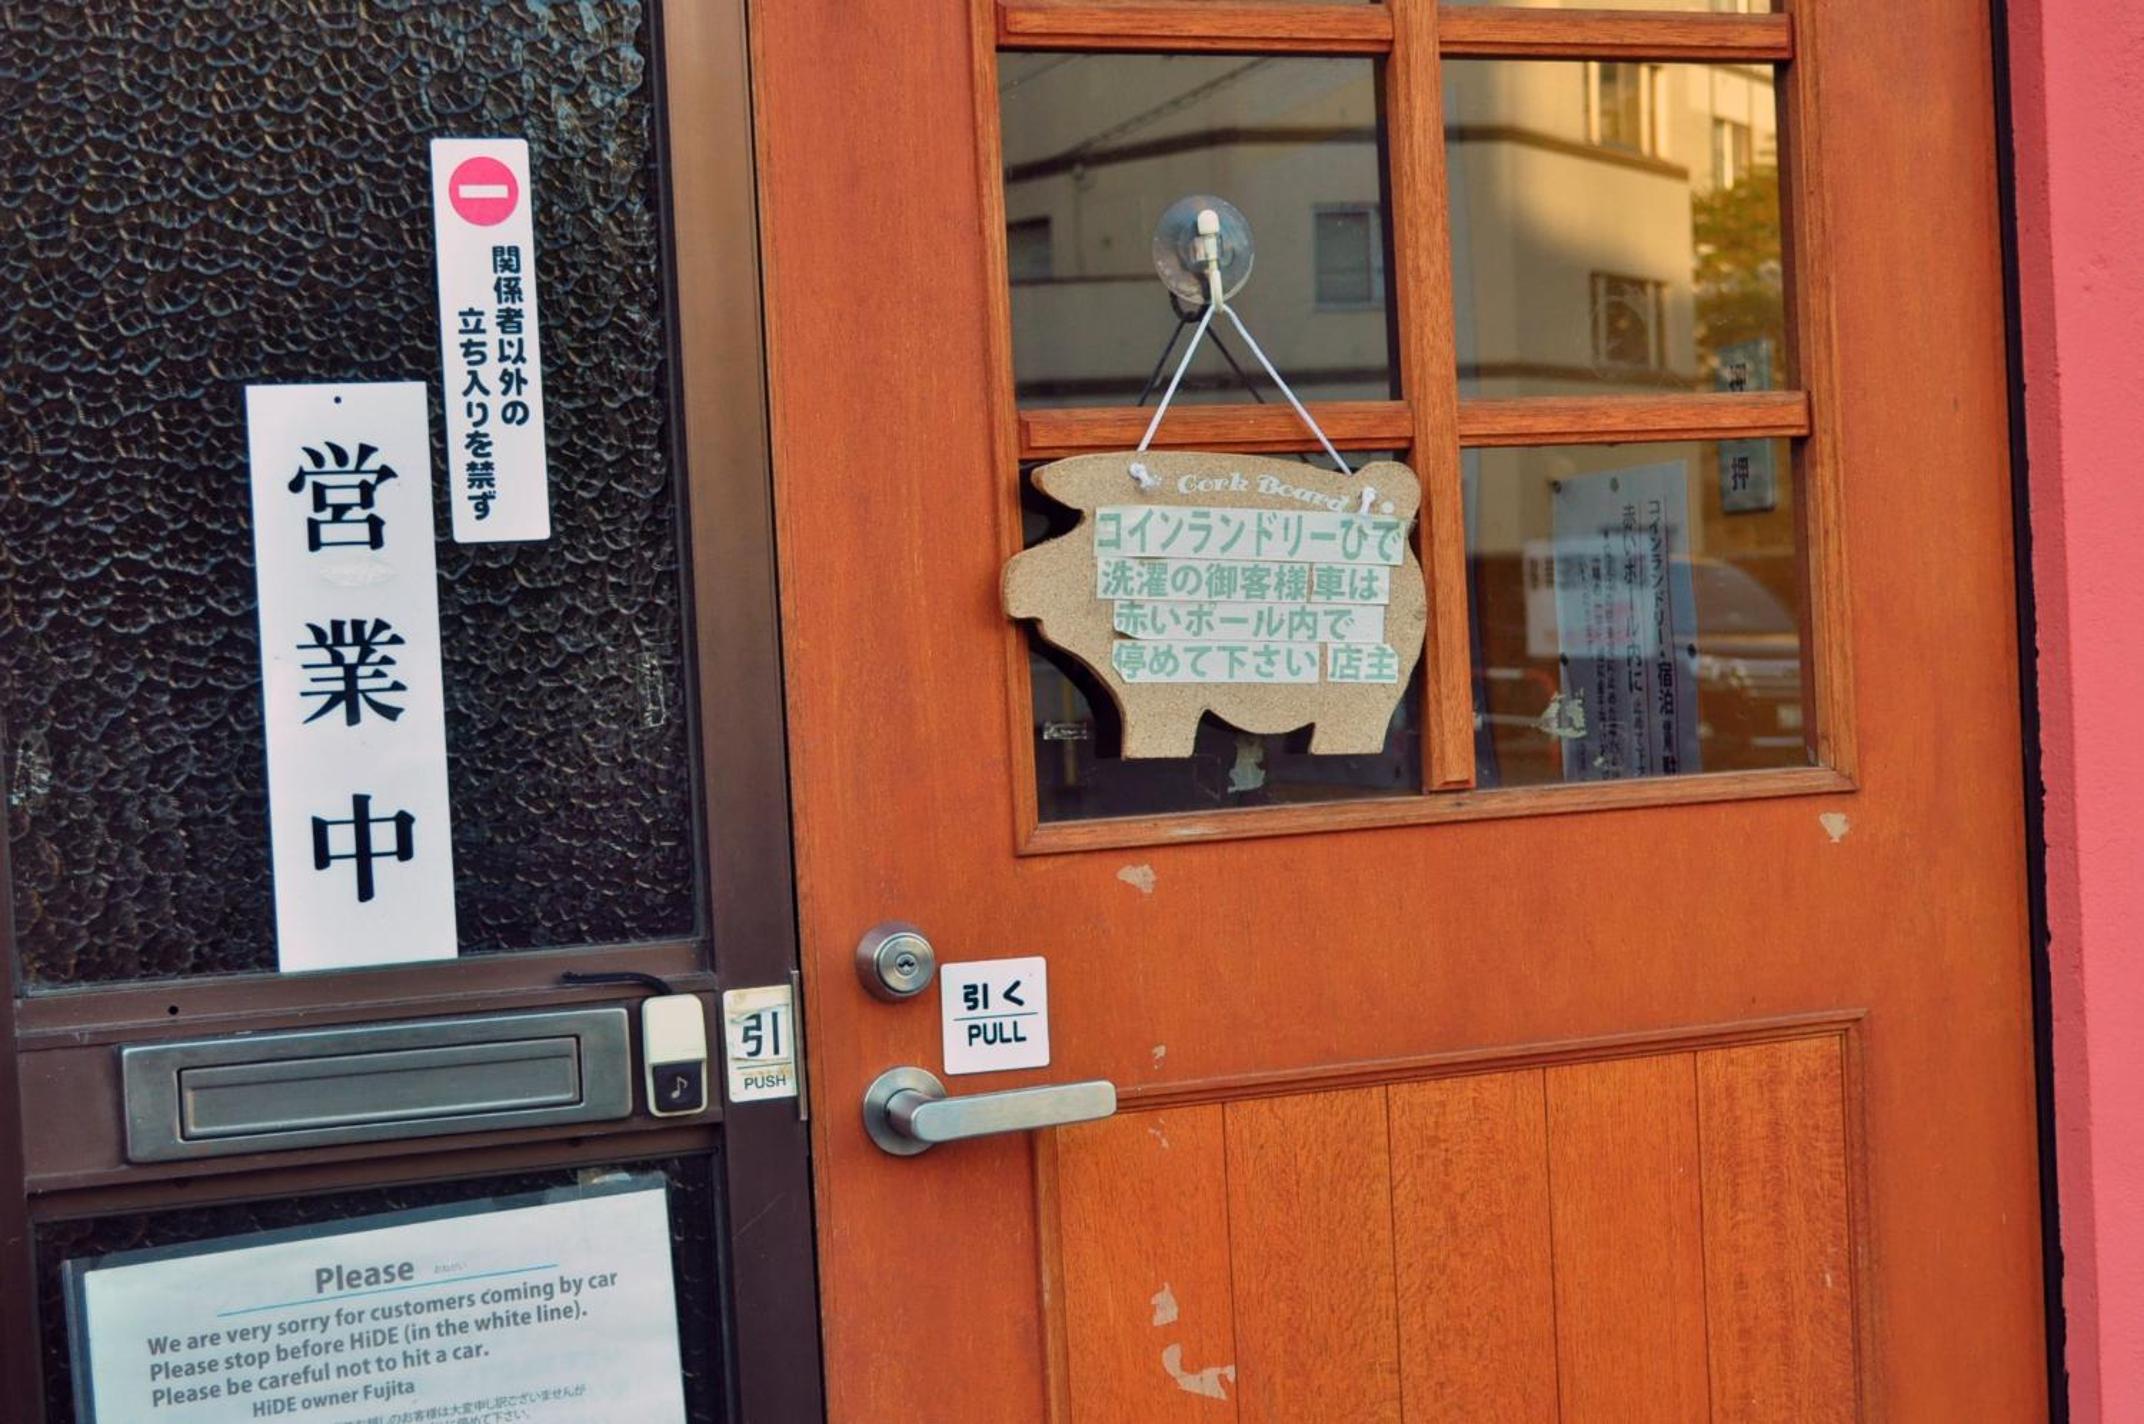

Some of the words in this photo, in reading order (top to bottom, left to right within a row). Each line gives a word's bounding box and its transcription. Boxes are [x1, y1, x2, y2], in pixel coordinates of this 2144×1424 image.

[491, 245, 530, 427] 関係者以外の
[458, 307, 497, 521] 立ち入りを禁ず
[1177, 471, 1249, 495] Cork
[1097, 508, 1402, 563] コインランドリーひで
[1115, 599, 1356, 642] 赤いポール内で
[287, 440, 416, 903] 営業中
[1114, 642, 1319, 681] 停めて下さい
[1329, 644, 1398, 682] 店主
[961, 979, 1026, 1012] 引く
[741, 1011, 780, 1058] 引
[967, 1020, 1028, 1047] PULL
[743, 1074, 787, 1091] PUSH
[315, 1260, 416, 1294] Please
[148, 1336, 181, 1355] We
[187, 1331, 221, 1350] are
[227, 1324, 272, 1343] very
[277, 1314, 331, 1335] sorry
[334, 1308, 365, 1326] for
[370, 1294, 477, 1320] customers
[481, 1281, 554, 1306] coming
[559, 1275, 583, 1296] by
[588, 1272, 618, 1289] car
[150, 1358, 220, 1382] Please
[224, 1349, 270, 1370] stop
[276, 1339, 344, 1362] before
[350, 1327, 399, 1351] HiDE
[404, 1324, 431, 1345] (in
[435, 1316, 470, 1338] the
[474, 1309, 532, 1332] white
[537, 1301, 588, 1324] line).
[152, 1385, 221, 1408] Please
[227, 1377, 253, 1396] be
[258, 1362, 330, 1391] careful
[336, 1358, 372, 1380] not
[376, 1355, 398, 1373] to
[402, 1349, 431, 1370] hit
[436, 1349, 447, 1364] a
[452, 1343, 490, 1361] car.
[252, 1396, 297, 1418] HiDE
[301, 1388, 358, 1410] owner
[363, 1380, 415, 1401] Fujita
